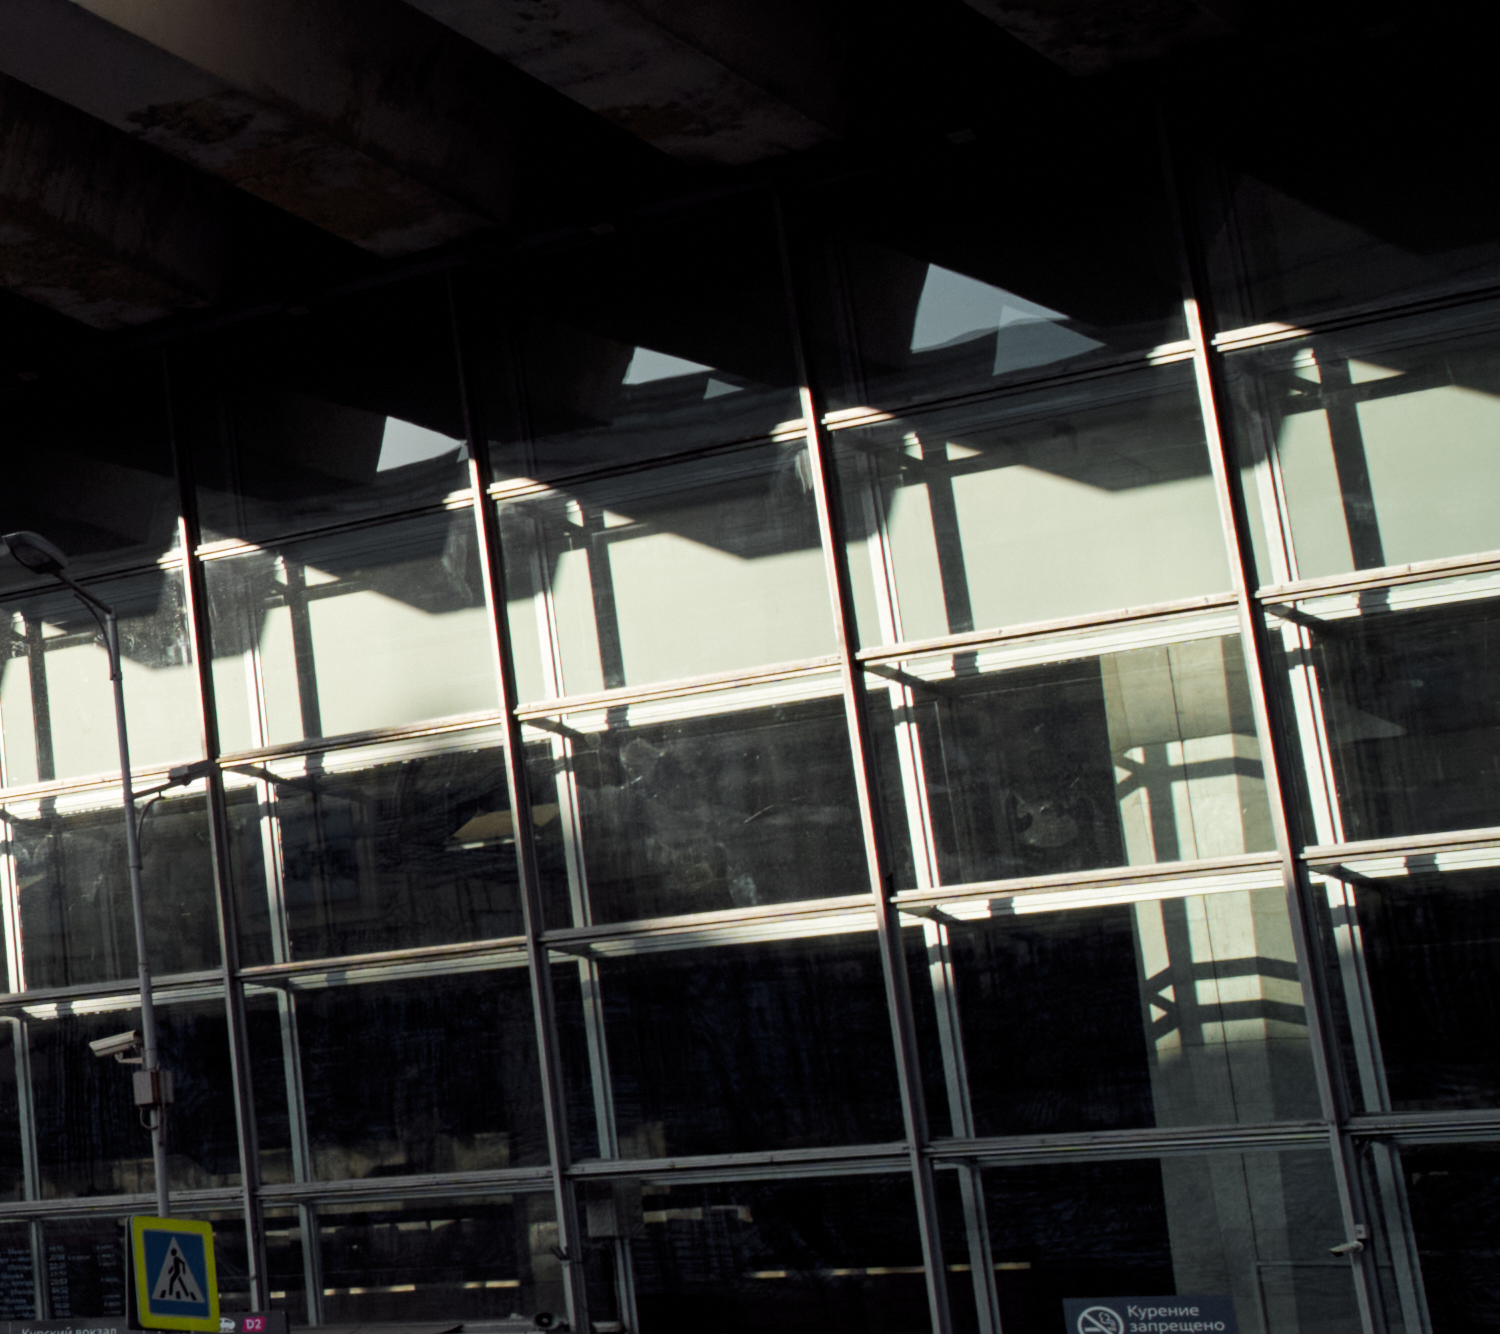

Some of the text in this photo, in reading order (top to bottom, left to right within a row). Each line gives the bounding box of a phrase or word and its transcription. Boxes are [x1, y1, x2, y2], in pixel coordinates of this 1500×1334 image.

[1126, 1305, 1200, 1320] Курение
[245, 1319, 262, 1330] D2
[1129, 1320, 1226, 1334] запрещено
